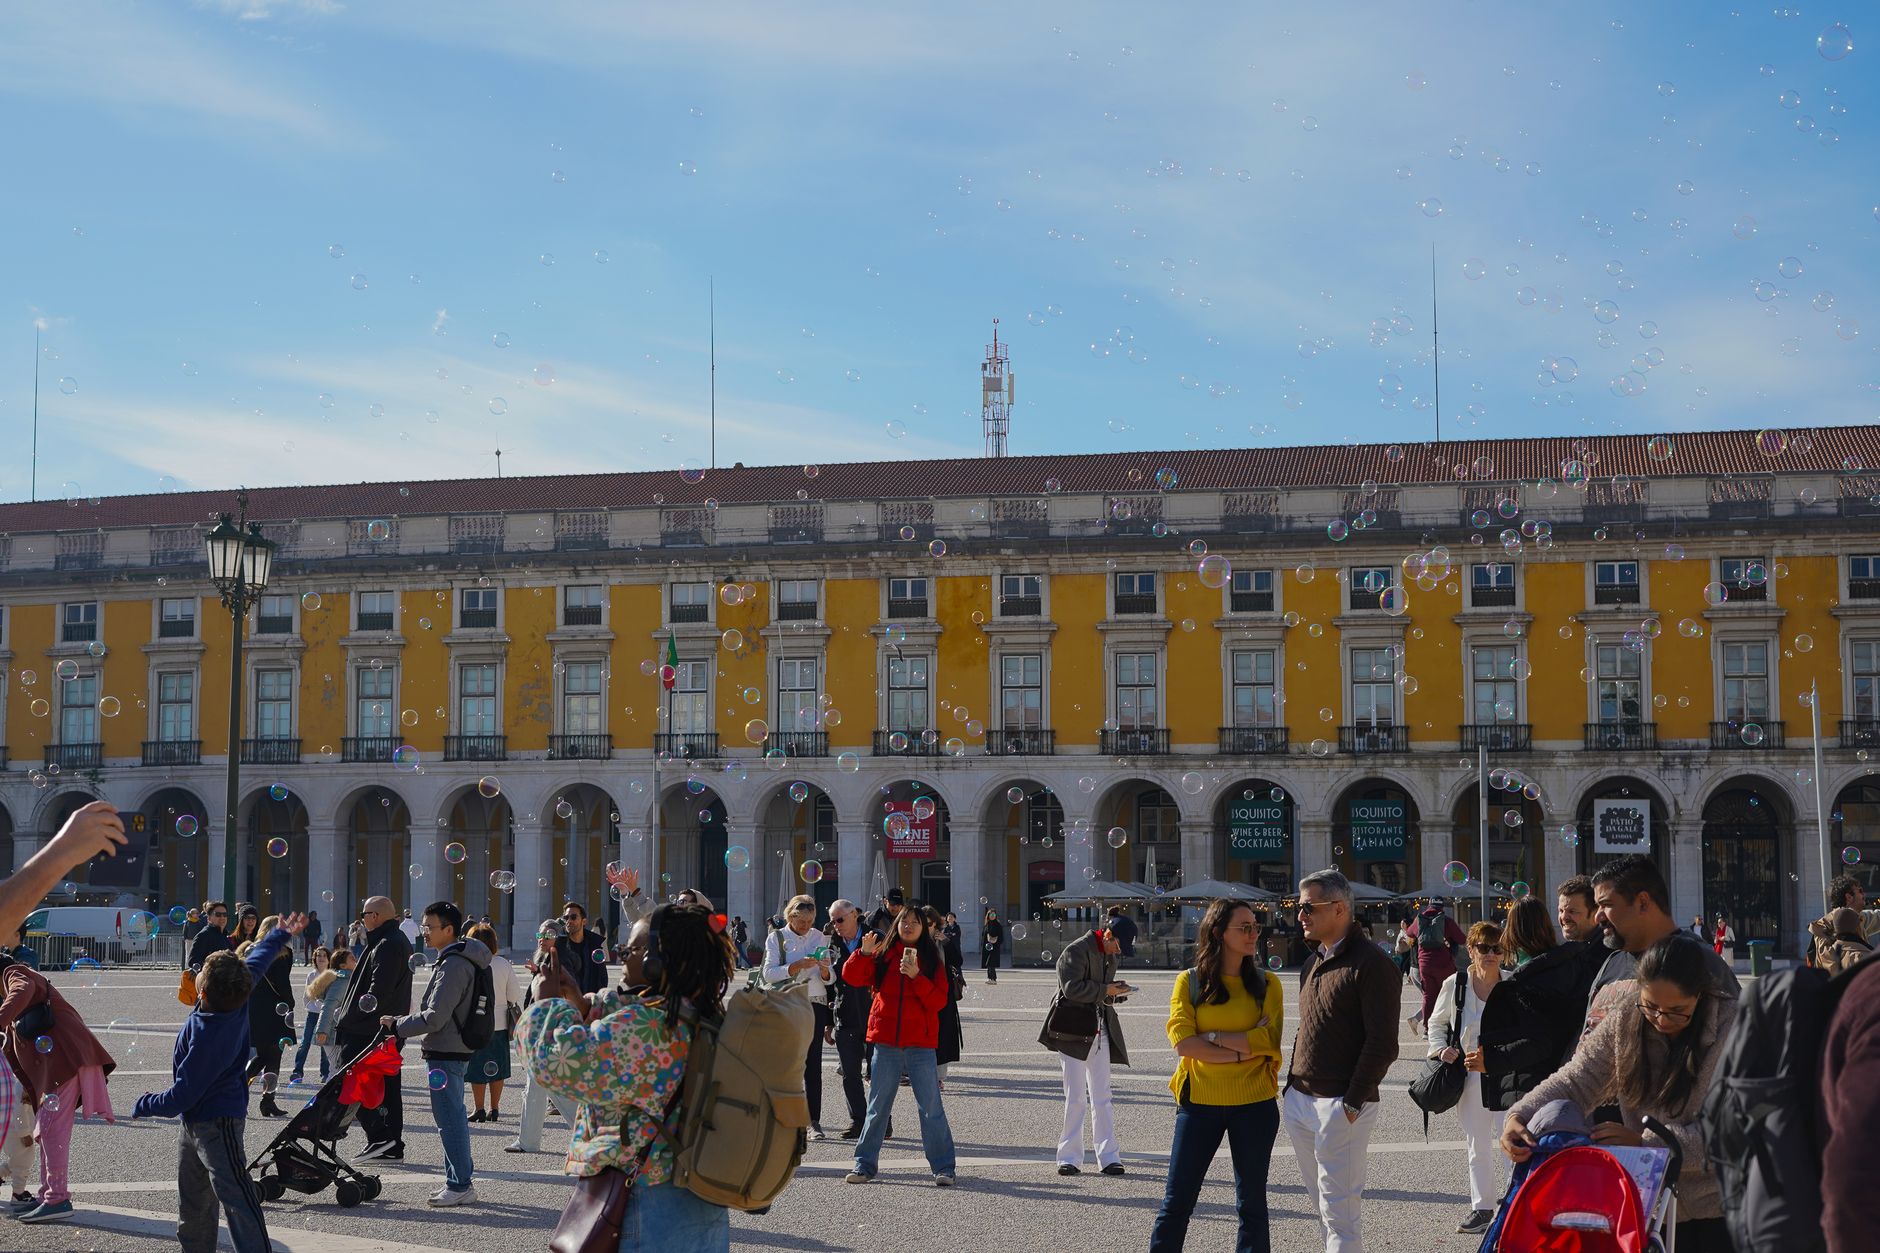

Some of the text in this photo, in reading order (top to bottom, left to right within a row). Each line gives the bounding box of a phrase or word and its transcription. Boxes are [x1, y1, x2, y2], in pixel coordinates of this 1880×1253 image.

[1610, 817, 1633, 825] PÁTIO
[893, 829, 930, 839] WINE
[1232, 828, 1282, 836] WINE & BEER
[1232, 839, 1282, 848] COCKTAILS
